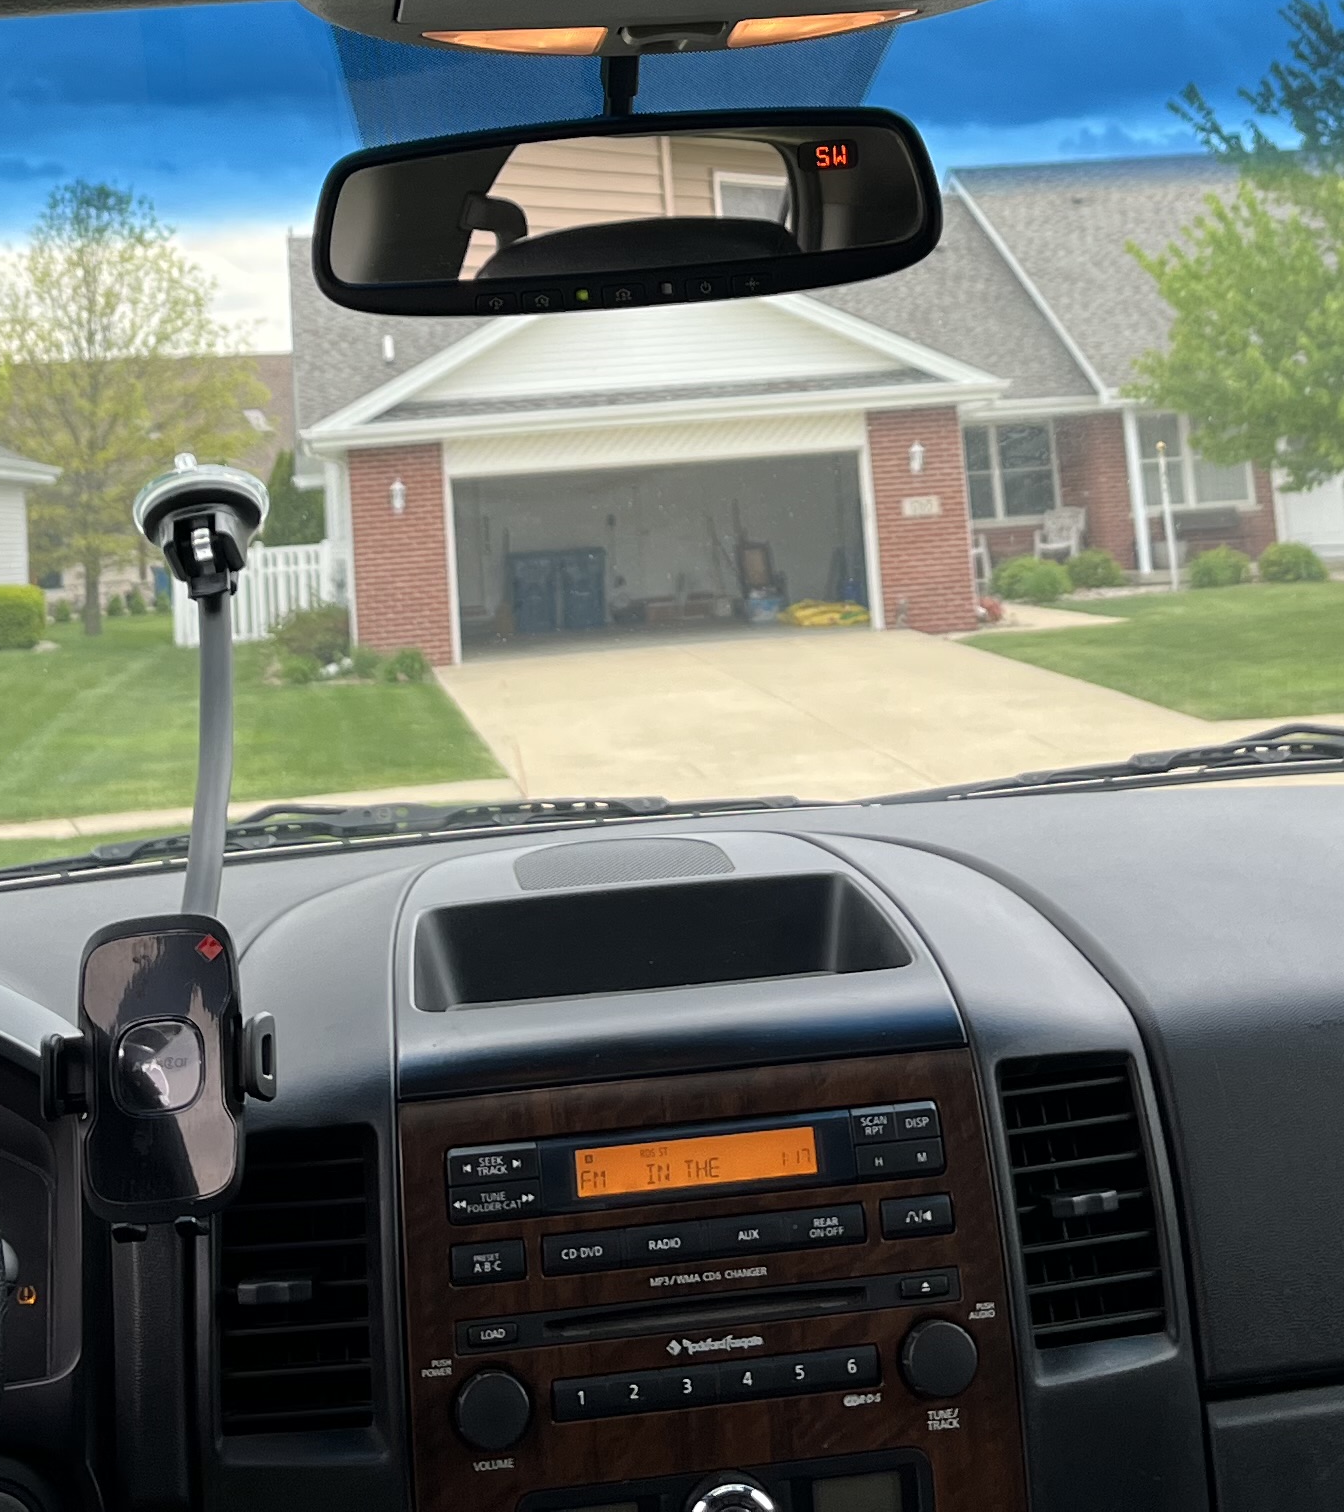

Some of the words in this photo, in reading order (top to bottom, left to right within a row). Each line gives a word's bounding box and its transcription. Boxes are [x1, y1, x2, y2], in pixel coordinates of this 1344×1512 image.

[816, 144, 847, 167] SW
[860, 1115, 888, 1127] SCAN
[905, 1116, 930, 1129] DISP
[865, 1126, 884, 1136] RPT
[640, 1149, 656, 1158] RDS
[658, 1147, 668, 1157] ST
[917, 1152, 928, 1163] M
[478, 1156, 504, 1166] SEEK
[874, 1157, 884, 1167] H
[476, 1165, 508, 1176] TRACK
[580, 1170, 607, 1190] FM
[646, 1163, 671, 1185] IN
[684, 1157, 720, 1179] THE
[480, 1191, 506, 1203] TUNE
[813, 1216, 839, 1228] REAR
[737, 1229, 760, 1241] AUX
[648, 1237, 681, 1251] RADIO
[649, 1272, 701, 1287] MP3/WMA
[725, 1266, 768, 1280] CHANGER
[968, 1309, 996, 1320] AUDIO
[480, 1328, 506, 1341] LOAD
[431, 1358, 452, 1368] PUSH
[421, 1366, 453, 1378] POWER
[577, 1390, 585, 1405] 1
[629, 1384, 640, 1400] 2
[682, 1378, 693, 1394] 3
[742, 1371, 753, 1386] 4
[794, 1364, 805, 1380] 5
[846, 1358, 857, 1374] 6
[927, 1407, 960, 1421] TUNE/
[927, 1418, 961, 1431] TRACK
[472, 1457, 515, 1472] VOLUME
